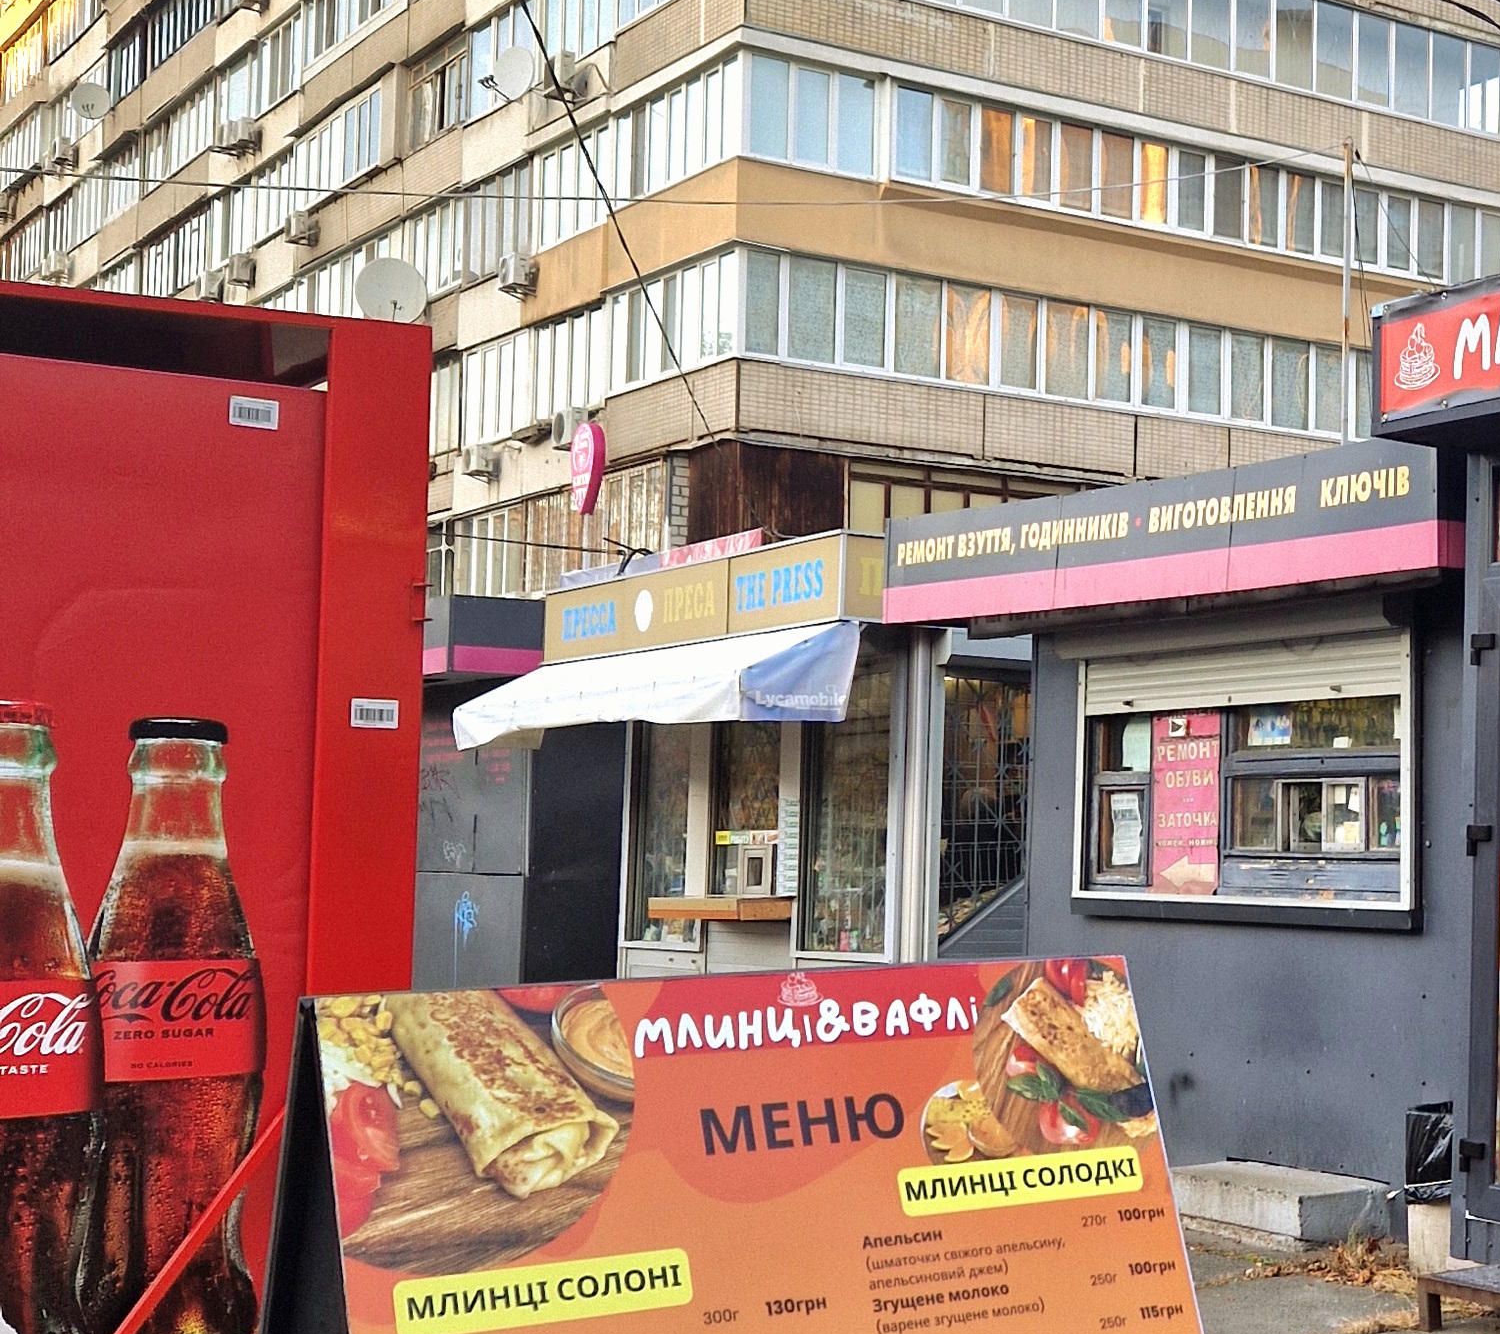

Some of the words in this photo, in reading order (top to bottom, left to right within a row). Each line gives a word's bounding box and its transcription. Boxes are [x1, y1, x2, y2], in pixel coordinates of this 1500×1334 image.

[896, 532, 956, 567] РЕМОНТ
[958, 525, 1016, 560] ВЗУТТЯ,
[1019, 511, 1130, 551] ГОДИННИКІВ
[1148, 484, 1298, 535] ВИГОТОВЛЕННЯ
[1320, 465, 1411, 508] КЛЮЧІВ
[735, 572, 766, 614] THE
[770, 559, 825, 608] PRESS
[663, 580, 716, 625] ПРЕСА
[1156, 740, 1219, 763] РЕМОНТ
[1165, 770, 1215, 789] ОБУВИ
[1157, 812, 1218, 829] ЗАТОЧКА
[113, 1029, 155, 1041] ZERO
[161, 1027, 215, 1040] SUGAR
[699, 1092, 906, 1156] МЕНЮ
[903, 1169, 1019, 1203] МЛИНЦІ
[1021, 1156, 1138, 1189] СОЛОДКІ
[1116, 1206, 1166, 1223] 100грн
[861, 1229, 944, 1251] Апельсин
[1127, 1259, 1177, 1277] 100грн
[406, 1279, 551, 1322] МЛИНЦІ
[556, 1263, 684, 1302] СОЛОНІ
[871, 1291, 946, 1316] Згущене
[947, 1283, 1010, 1303] молоко
[764, 1296, 828, 1317] 130грн
[1138, 1303, 1185, 1321] 115грн
